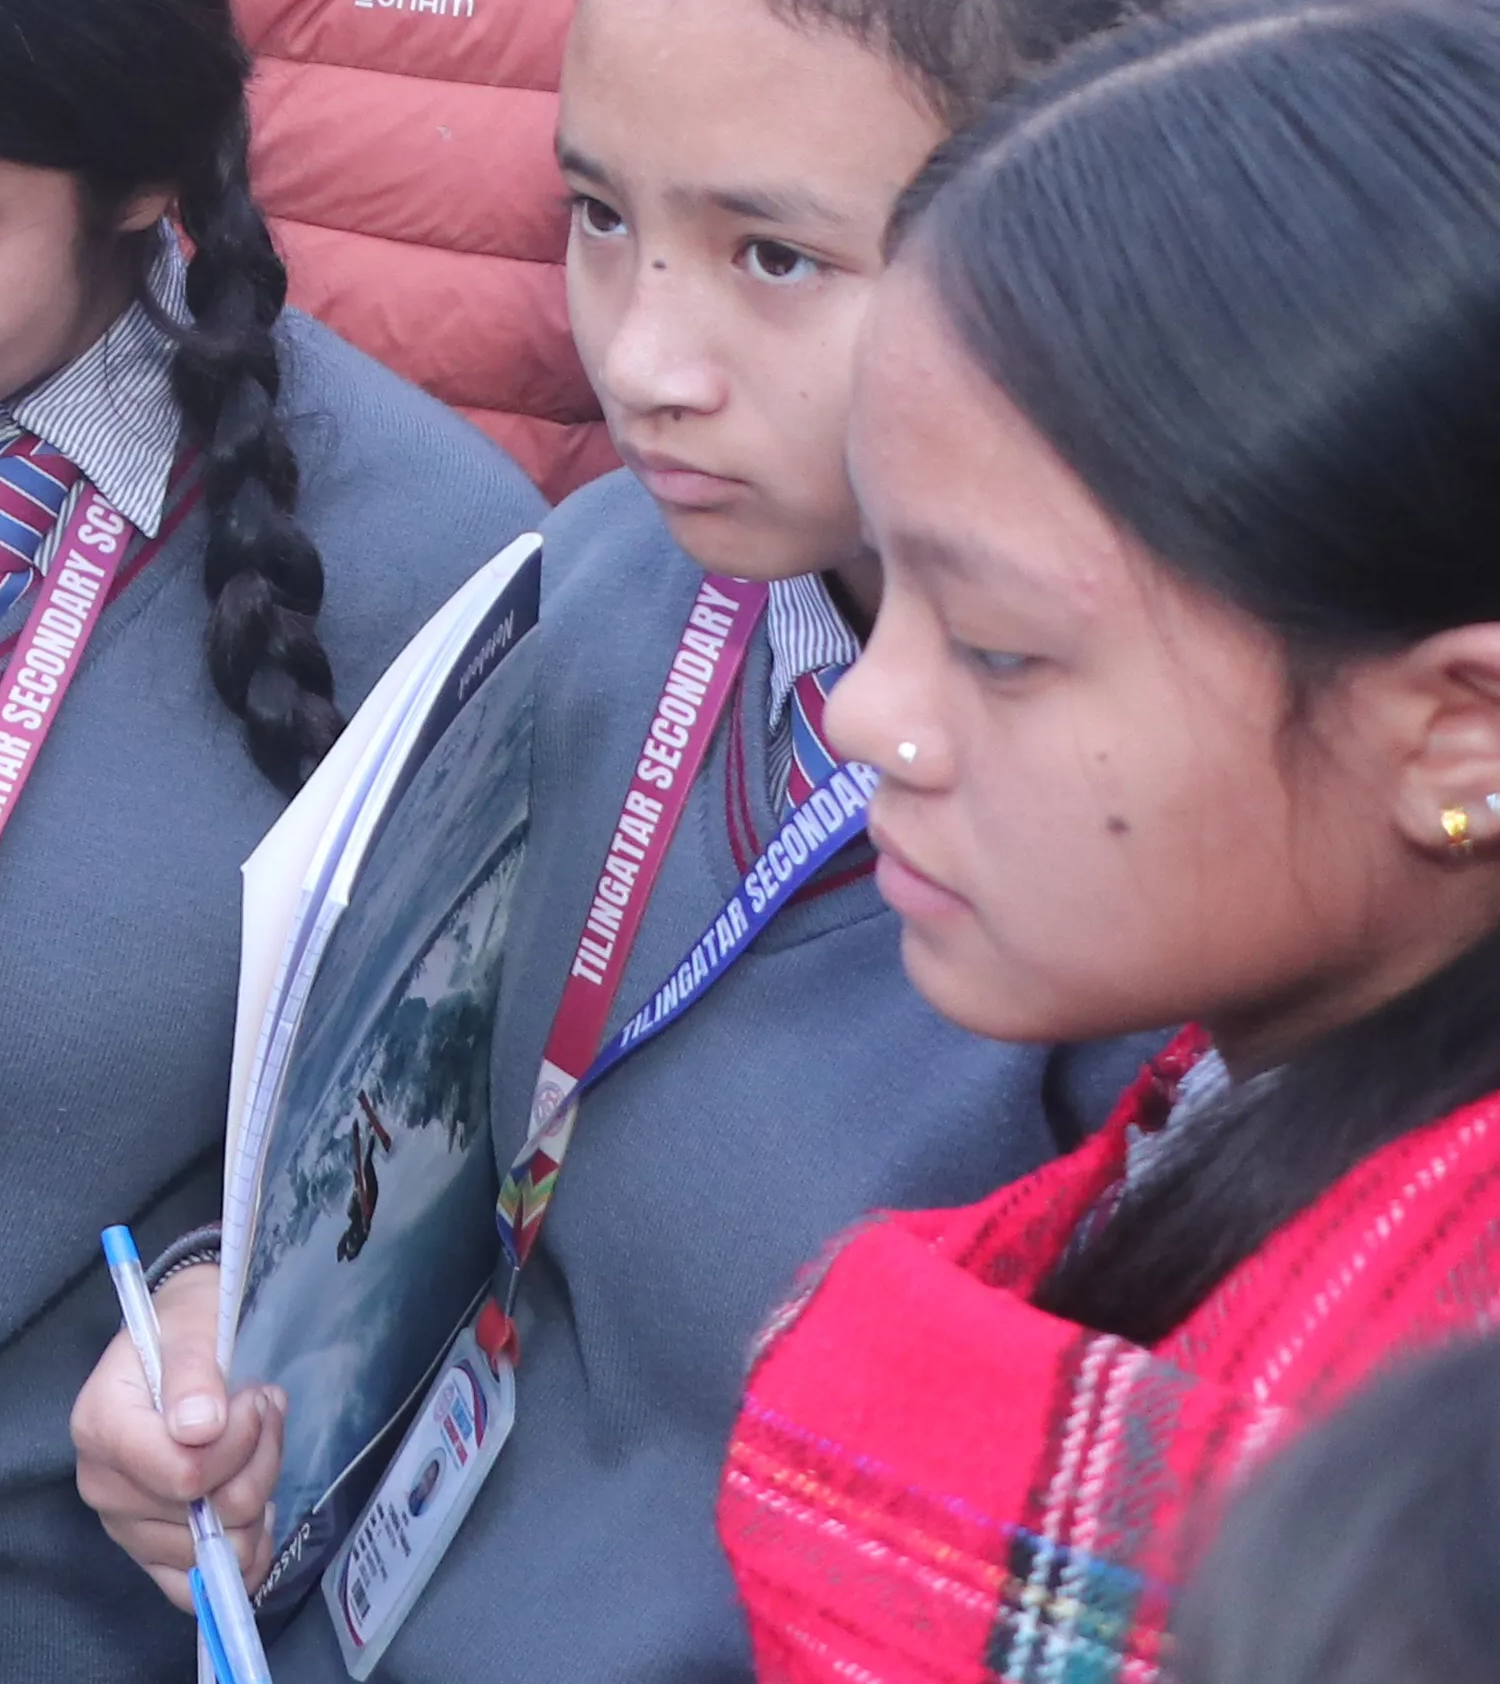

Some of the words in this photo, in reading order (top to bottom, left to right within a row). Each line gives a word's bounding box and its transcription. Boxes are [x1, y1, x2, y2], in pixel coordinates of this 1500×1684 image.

[1, 548, 106, 731] SECONDARY
[570, 787, 663, 986] TILINGATAR
[637, 582, 741, 791] SECONDARY
[618, 893, 751, 1050] TILINGATAR
[743, 760, 882, 916] SECONDAR
[253, 1521, 312, 1613] classma
